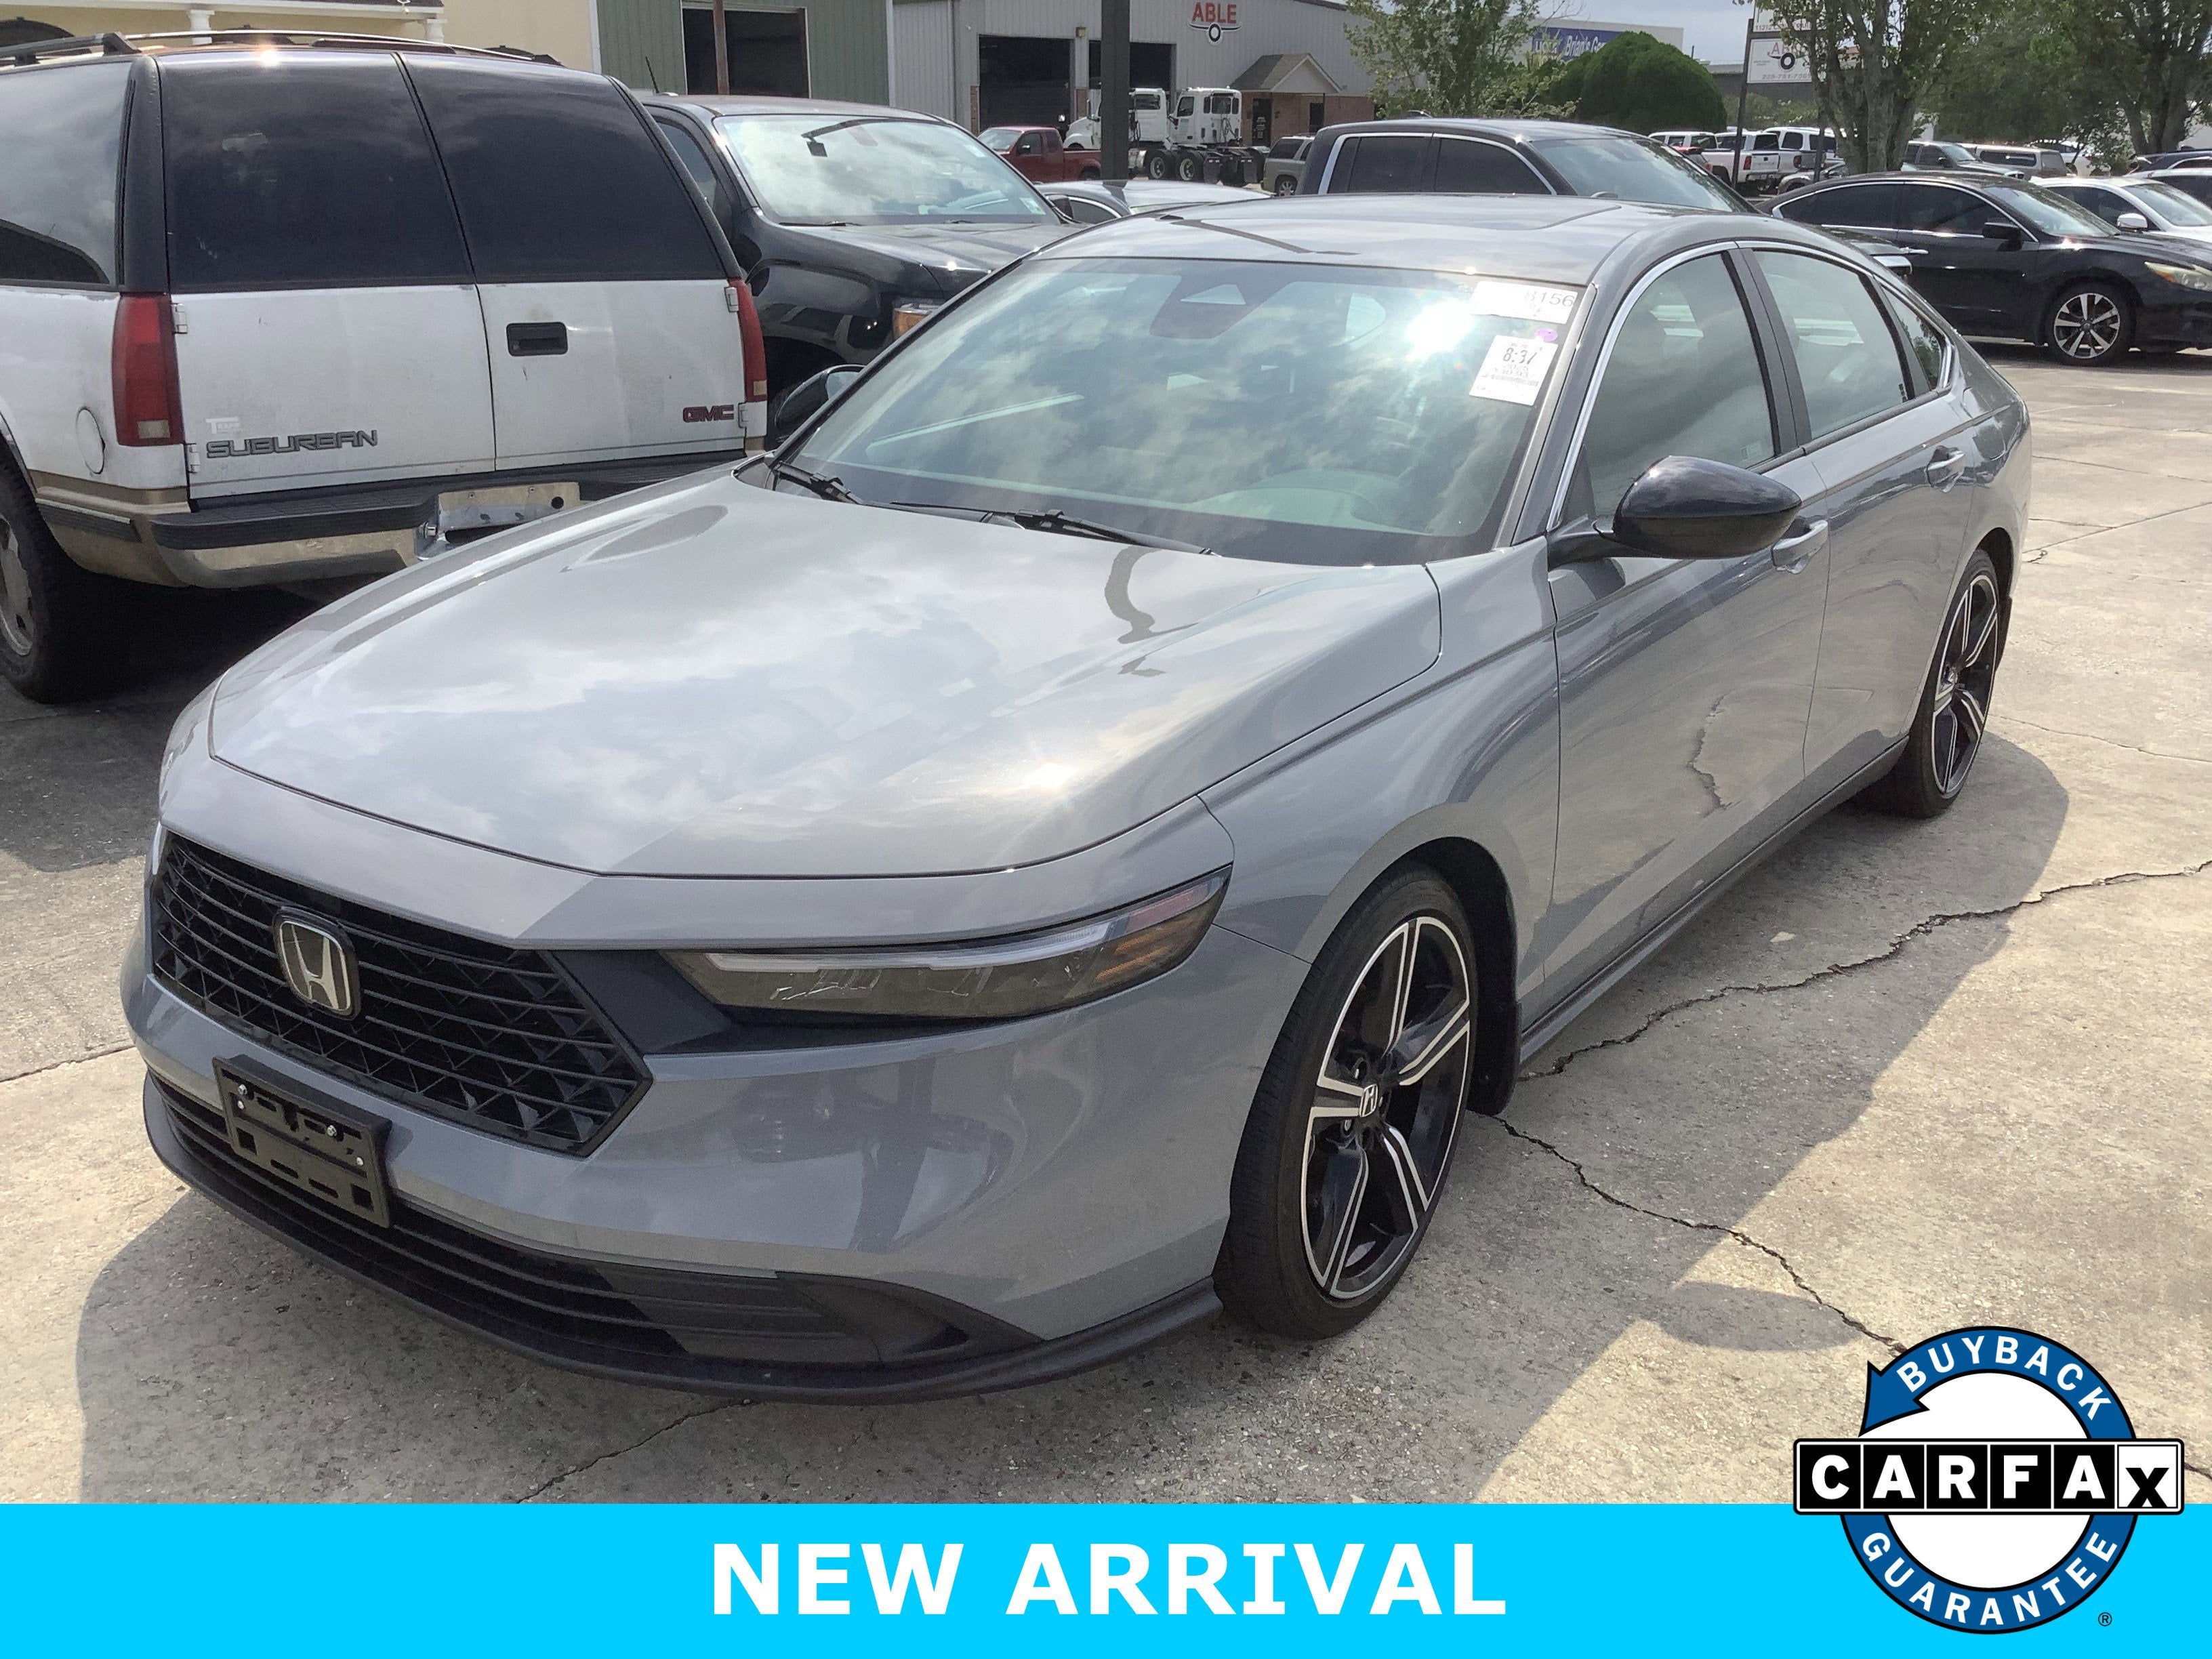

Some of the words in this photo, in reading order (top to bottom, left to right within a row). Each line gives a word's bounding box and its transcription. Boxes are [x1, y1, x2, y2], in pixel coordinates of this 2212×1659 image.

[1192, 2, 1237, 24] ABLE
[682, 405, 734, 423] GMC
[206, 430, 377, 459] SUBURBAN
